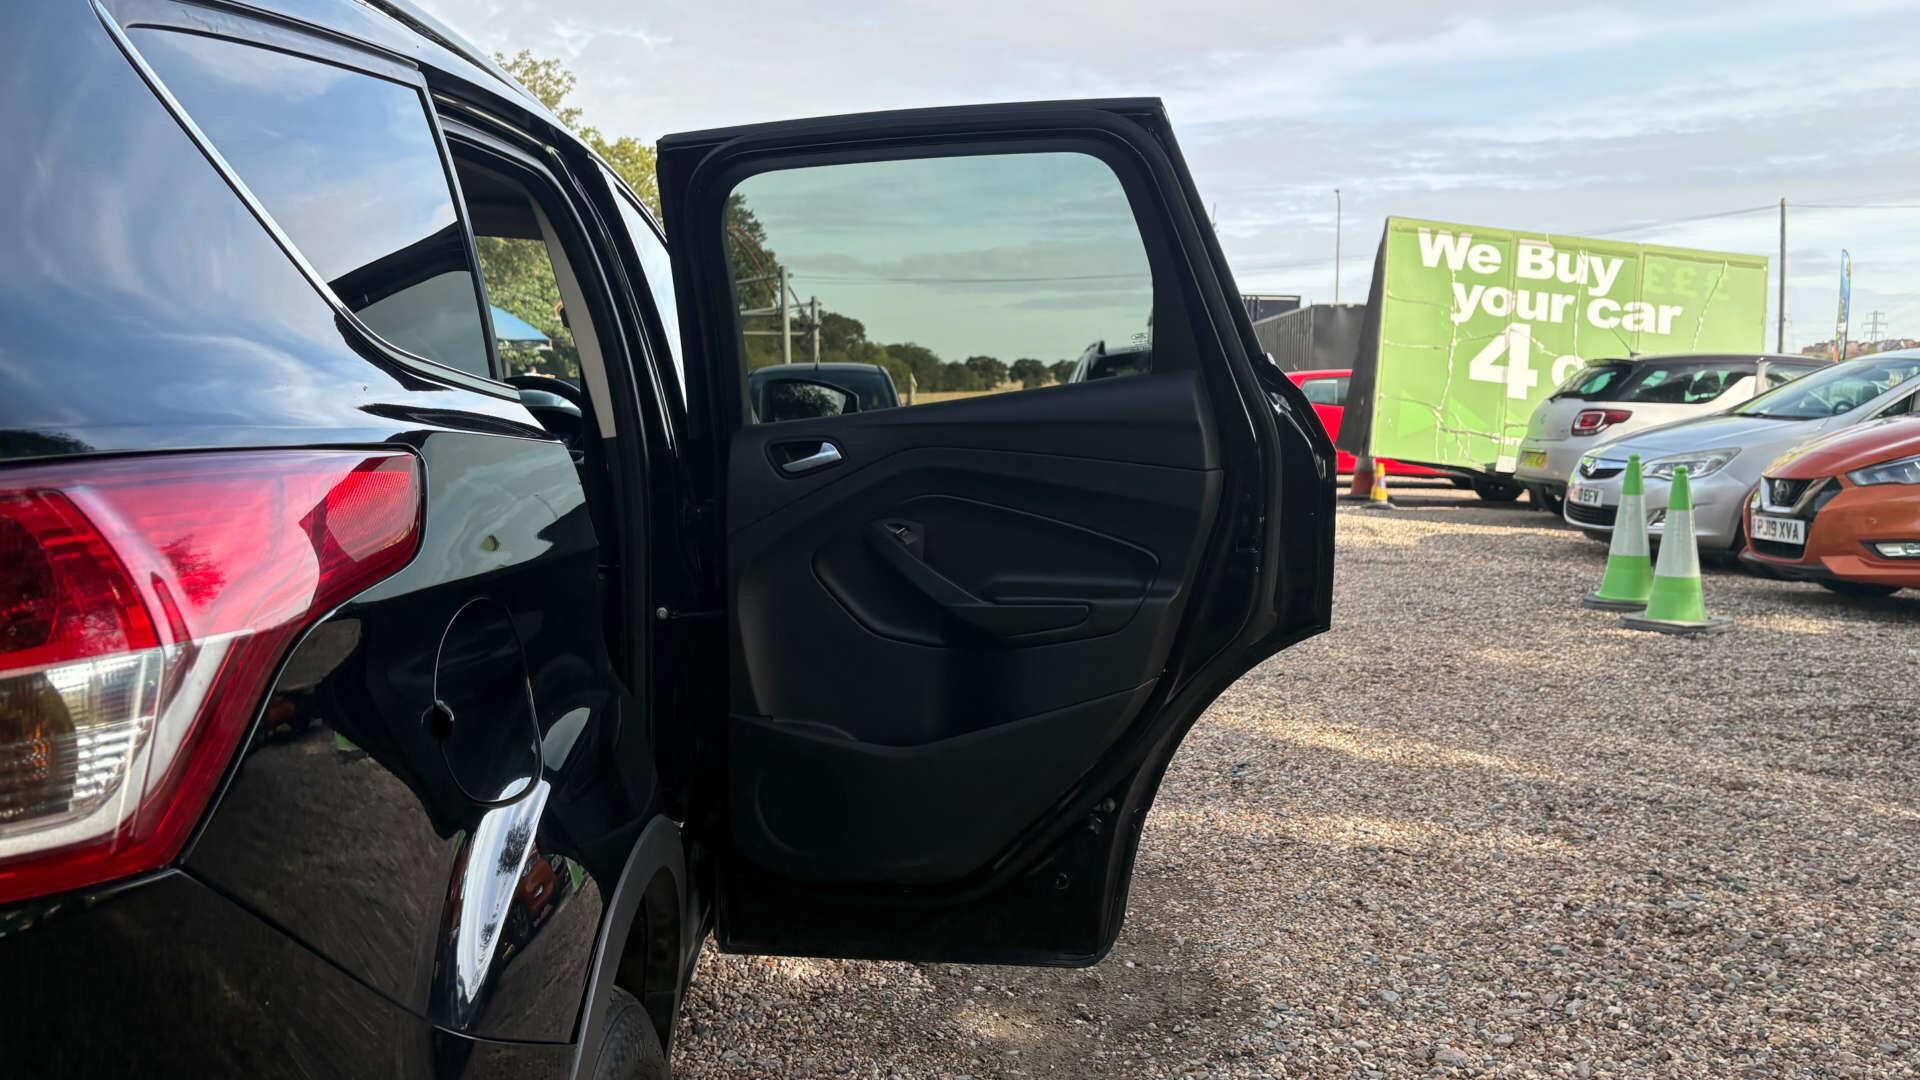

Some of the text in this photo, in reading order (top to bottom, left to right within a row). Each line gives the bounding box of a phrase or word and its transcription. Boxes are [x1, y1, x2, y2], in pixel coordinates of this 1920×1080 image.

[1418, 227, 1624, 297] We Buy
[1451, 282, 1684, 335] your car
[1469, 322, 1538, 400] 4
[1779, 520, 1799, 541] XVA
